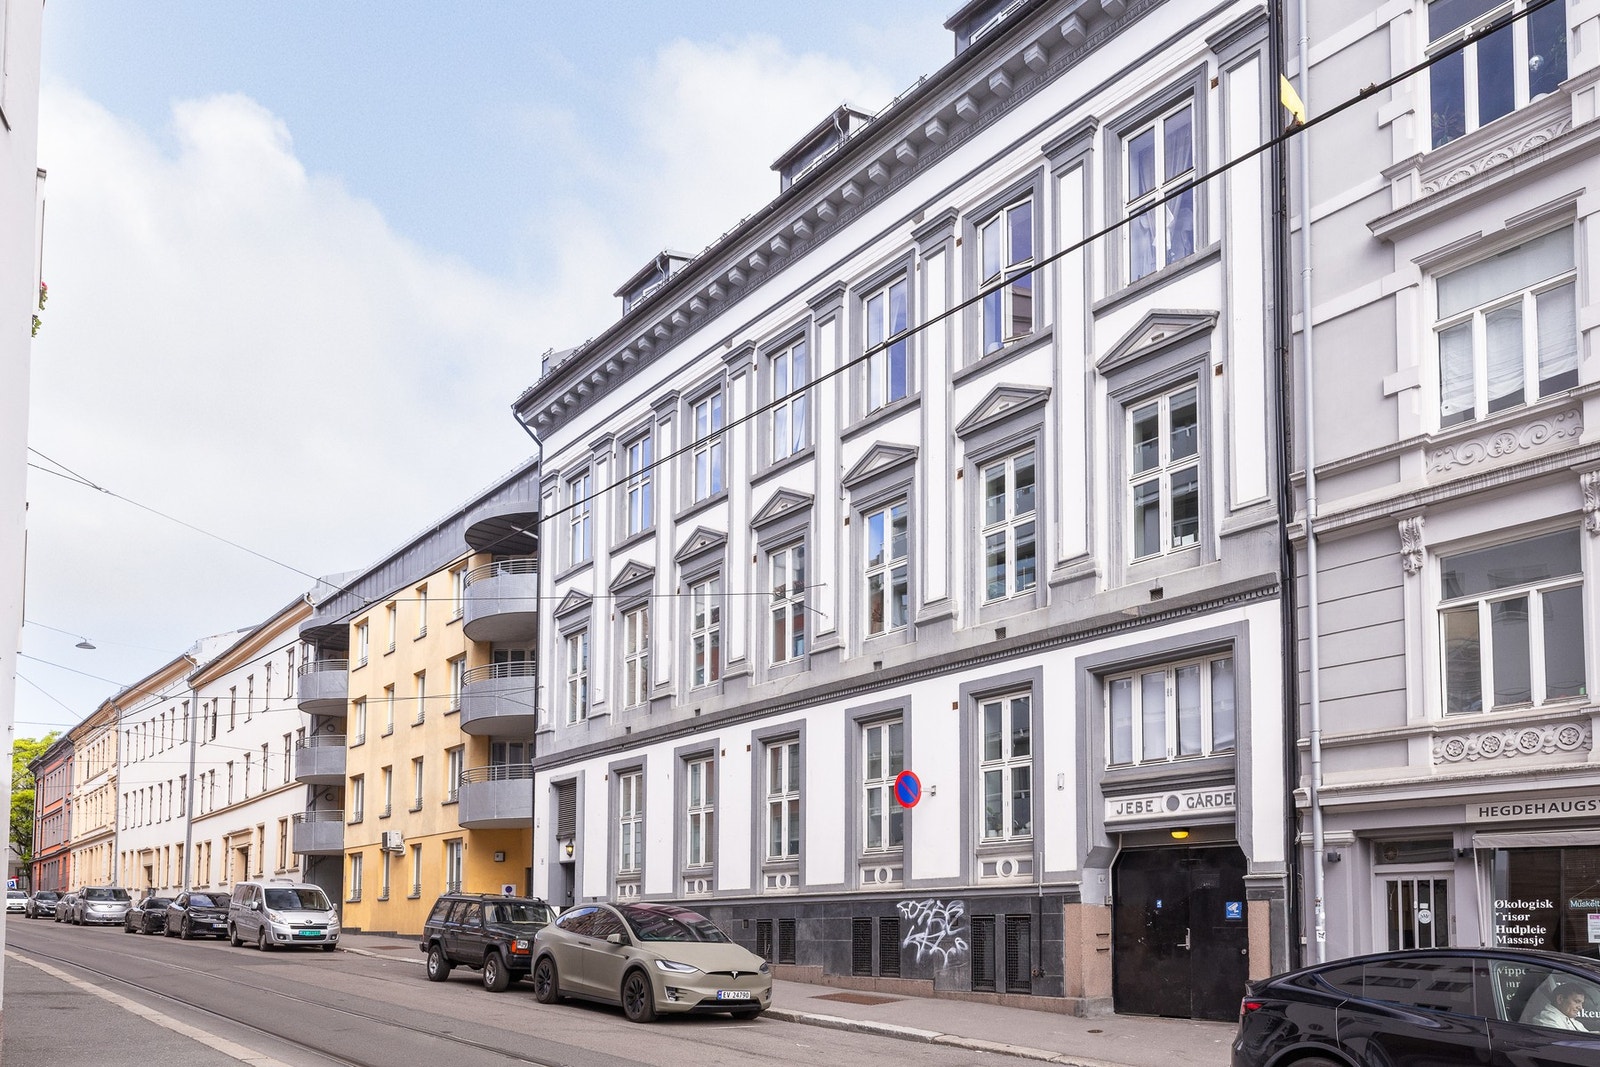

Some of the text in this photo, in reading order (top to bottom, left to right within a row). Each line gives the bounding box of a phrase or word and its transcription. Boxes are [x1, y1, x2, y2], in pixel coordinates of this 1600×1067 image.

[1116, 800, 1154, 815] JEBE
[1479, 799, 1600, 818] HEGDEHAUGS
[1494, 899, 1554, 910] Økologisk
[1495, 924, 1547, 936] Hudpleie
[1496, 935, 1545, 947] Massasje
